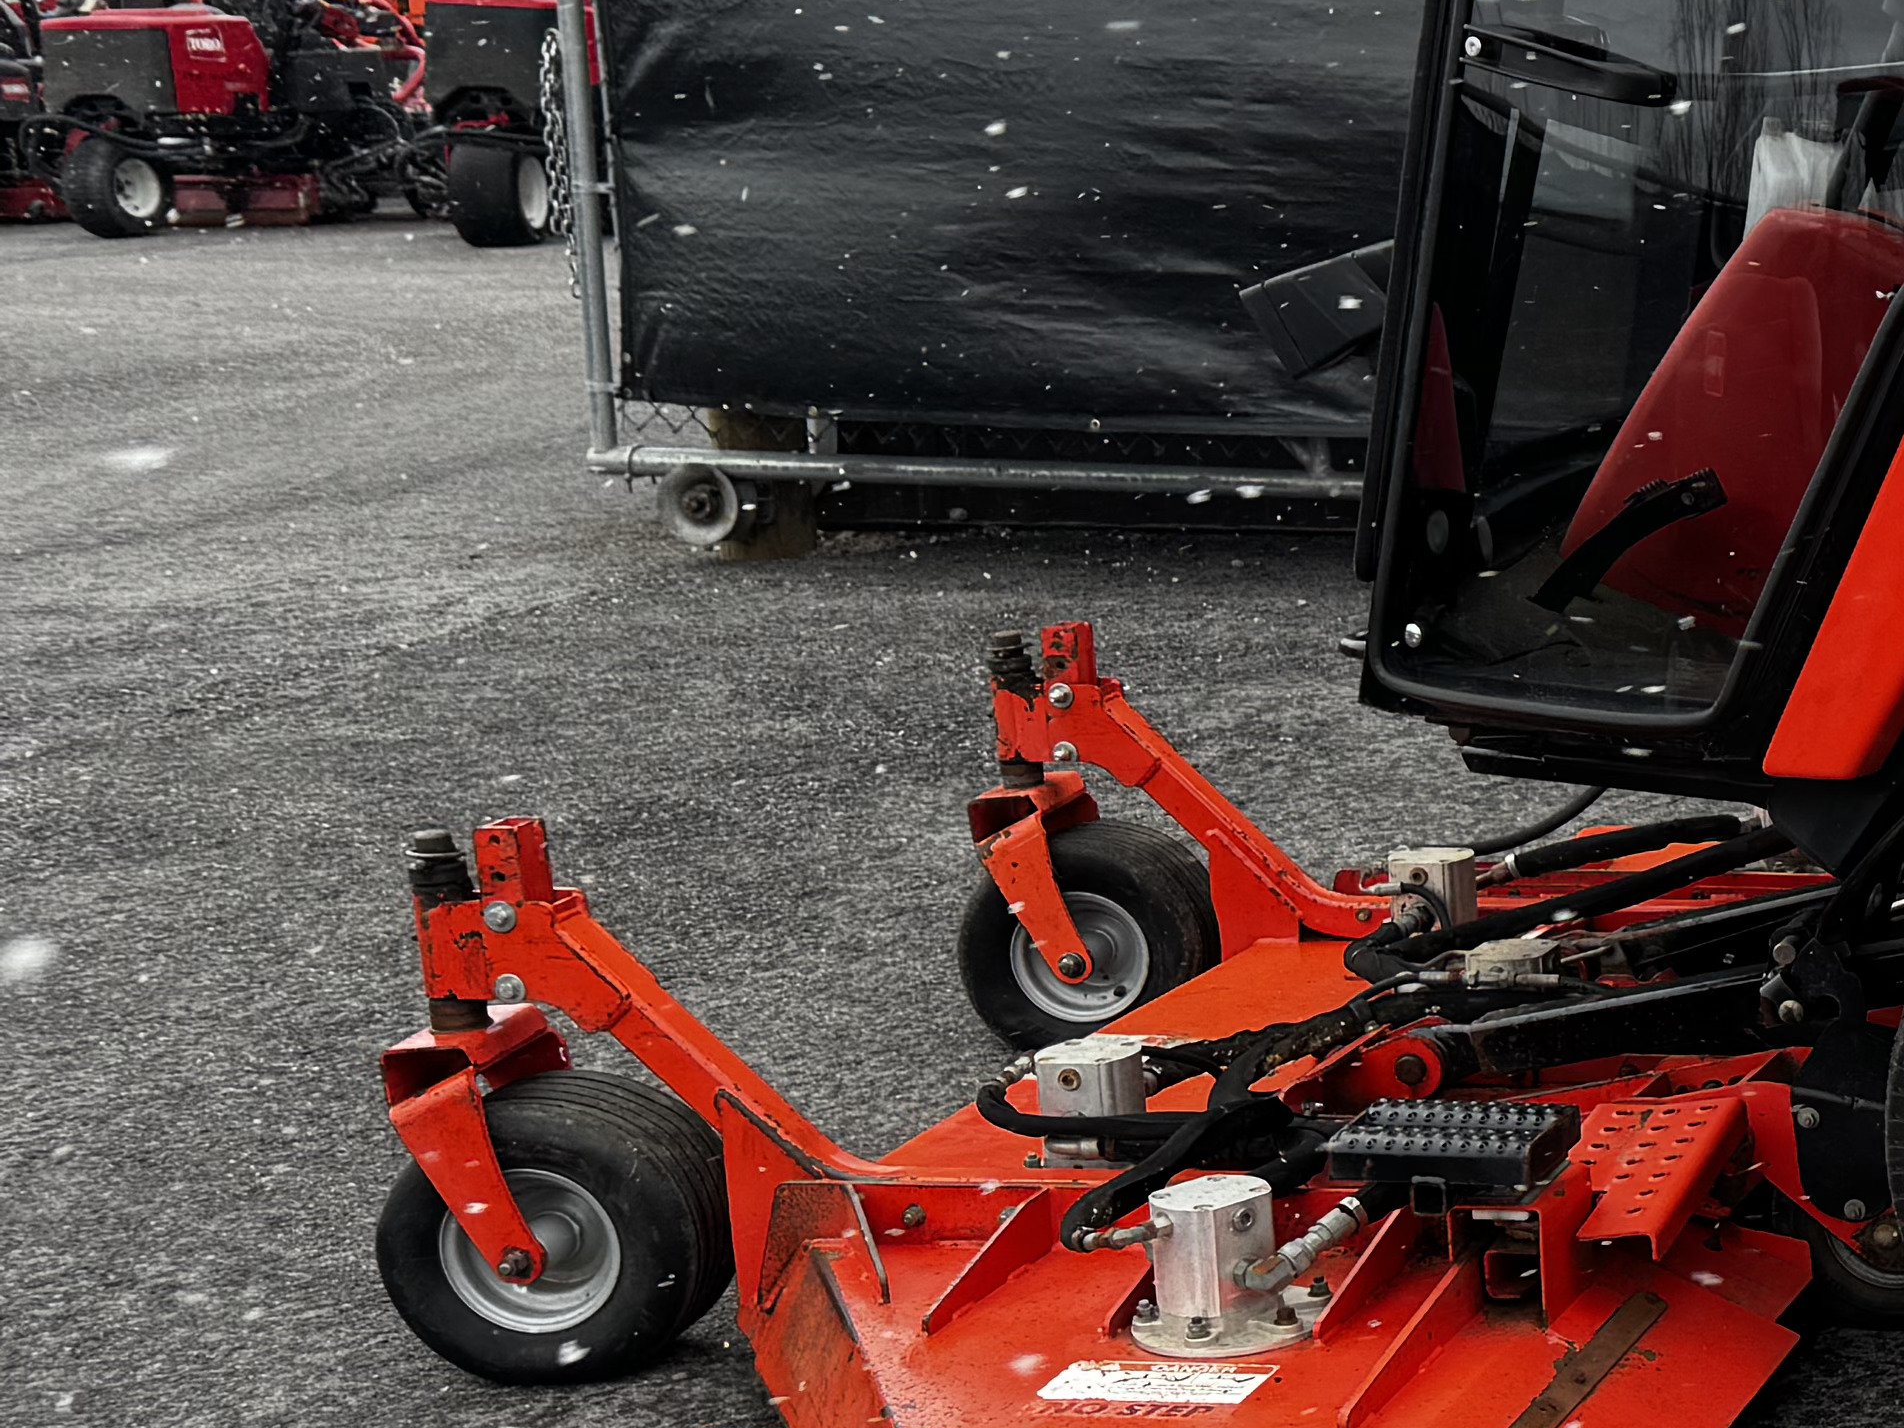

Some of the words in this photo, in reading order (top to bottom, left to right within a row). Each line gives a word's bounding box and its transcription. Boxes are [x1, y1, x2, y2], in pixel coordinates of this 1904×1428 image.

[187, 37, 221, 52] TORO
[1151, 1364, 1238, 1374] DANGER
[1042, 1401, 1109, 1415] NO
[1118, 1404, 1215, 1417] STEP
